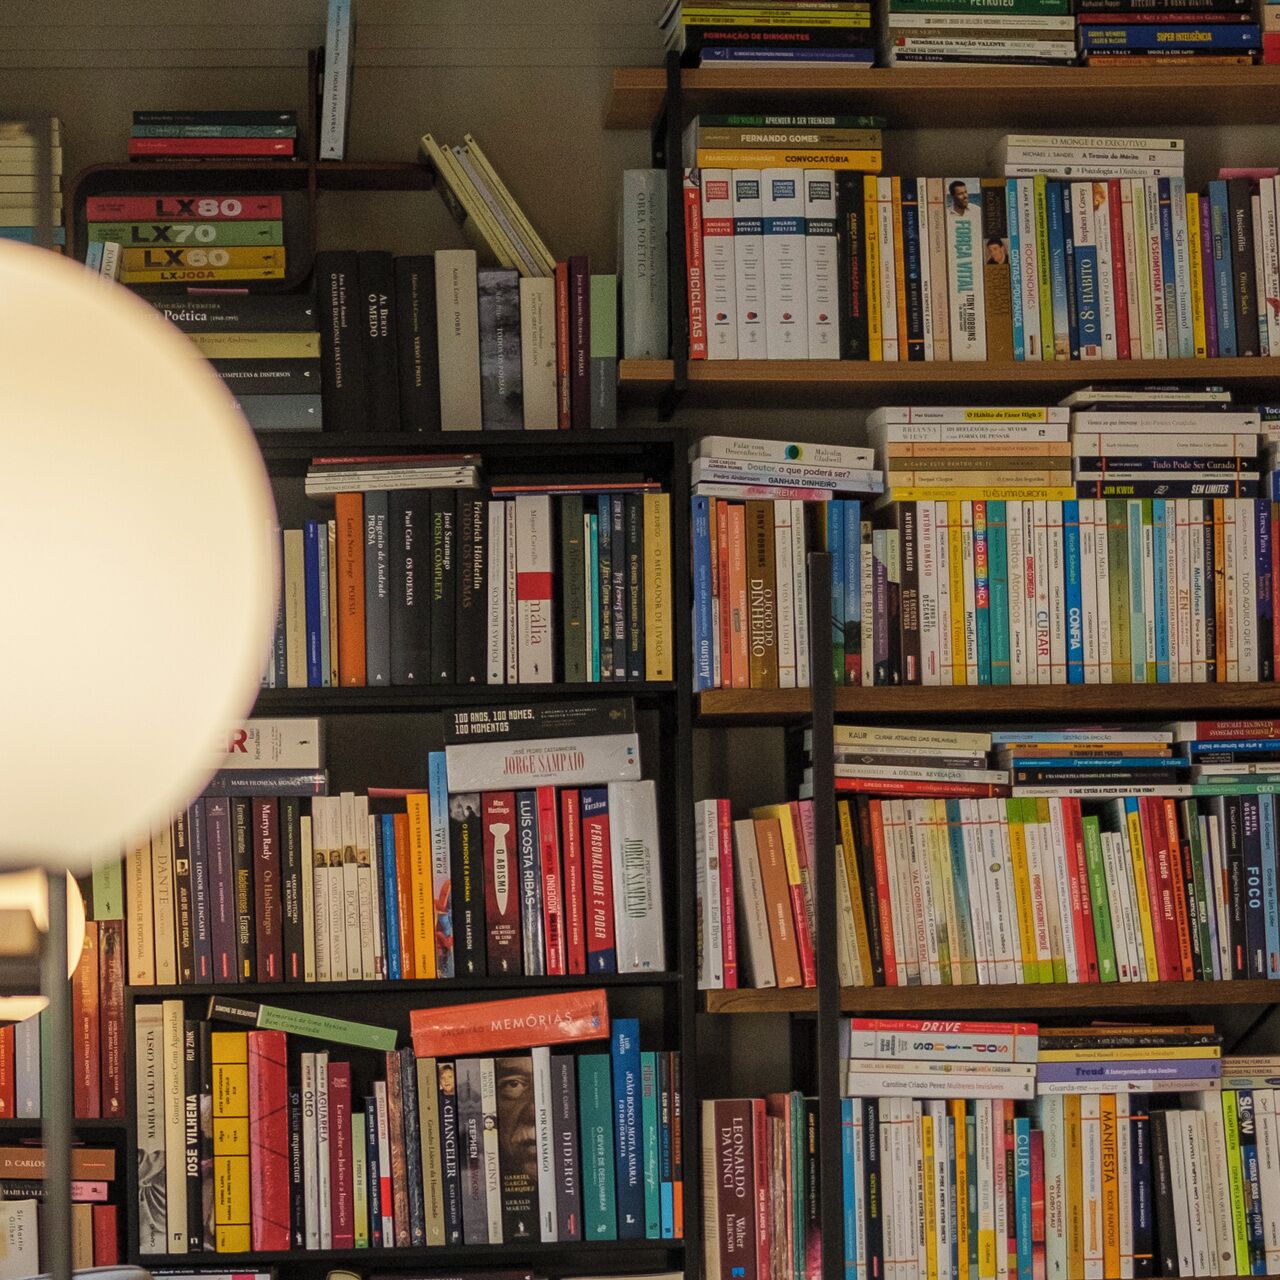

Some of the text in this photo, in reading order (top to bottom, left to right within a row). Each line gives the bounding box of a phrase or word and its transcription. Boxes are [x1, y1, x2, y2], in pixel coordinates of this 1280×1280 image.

[741, 134, 818, 143] FERNANDO GOMES
[155, 199, 242, 217] LX80
[131, 225, 216, 243] LX70
[143, 249, 229, 267] LX60
[160, 271, 215, 280] LXJOGA
[955, 220, 972, 294] FORÇA VITAL
[1025, 244, 1034, 309] ROCKONOMICS
[690, 268, 701, 337] BICICLETAS
[1012, 250, 1020, 327] CONTAS-POUPANÇA
[164, 310, 207, 321] Poética
[769, 477, 836, 488] GANHAR DINHEIRO
[786, 468, 801, 476] que
[804, 468, 832, 478] poderá
[837, 470, 850, 478] ser?
[1117, 486, 1134, 494] KWIK
[1192, 486, 1204, 494] SEM
[1206, 486, 1228, 494] LIMITES
[376, 515, 384, 548] Eugénio
[443, 512, 451, 570] José Saramago
[474, 502, 482, 589] Friedrich Hölderlin
[378, 552, 384, 560] de
[405, 558, 412, 568] OS
[751, 578, 765, 657] DINHEIRO
[764, 589, 774, 646] O JOGO DO
[1038, 611, 1048, 656] CURAR
[1069, 607, 1079, 650] CONFIA
[700, 640, 709, 677] Autismo
[455, 713, 468, 723] 100
[494, 711, 506, 721] 100
[455, 723, 509, 734] 100 MOMENTOS
[503, 753, 584, 775] JORGE SAMPAIO
[261, 805, 271, 860] Martyn Rady
[521, 801, 534, 904] LUÍS COSTA RIBAS
[591, 824, 604, 895] PERSONALIDADE
[497, 859, 505, 894] ABISMO
[1247, 866, 1259, 908] FOCO
[594, 909, 605, 938] PODER
[491, 1010, 572, 1030] MEMÓRIAS
[187, 1031, 195, 1061] RUI ZINK
[187, 1095, 197, 1144] VILHENA
[305, 1091, 313, 1117] ÓLEO
[319, 1091, 328, 1142] AGUARELA
[444, 1105, 455, 1178] CHANCELER
[468, 1119, 477, 1158] STEPHEN
[722, 1128, 733, 1188] DA VINCI
[733, 1118, 745, 1198] LEONARDO
[1018, 1135, 1027, 1178] CURA
[1103, 1112, 1113, 1182] MANIFESTA
[562, 1132, 574, 1196] DIDEROT
[736, 1217, 745, 1248] Walter
